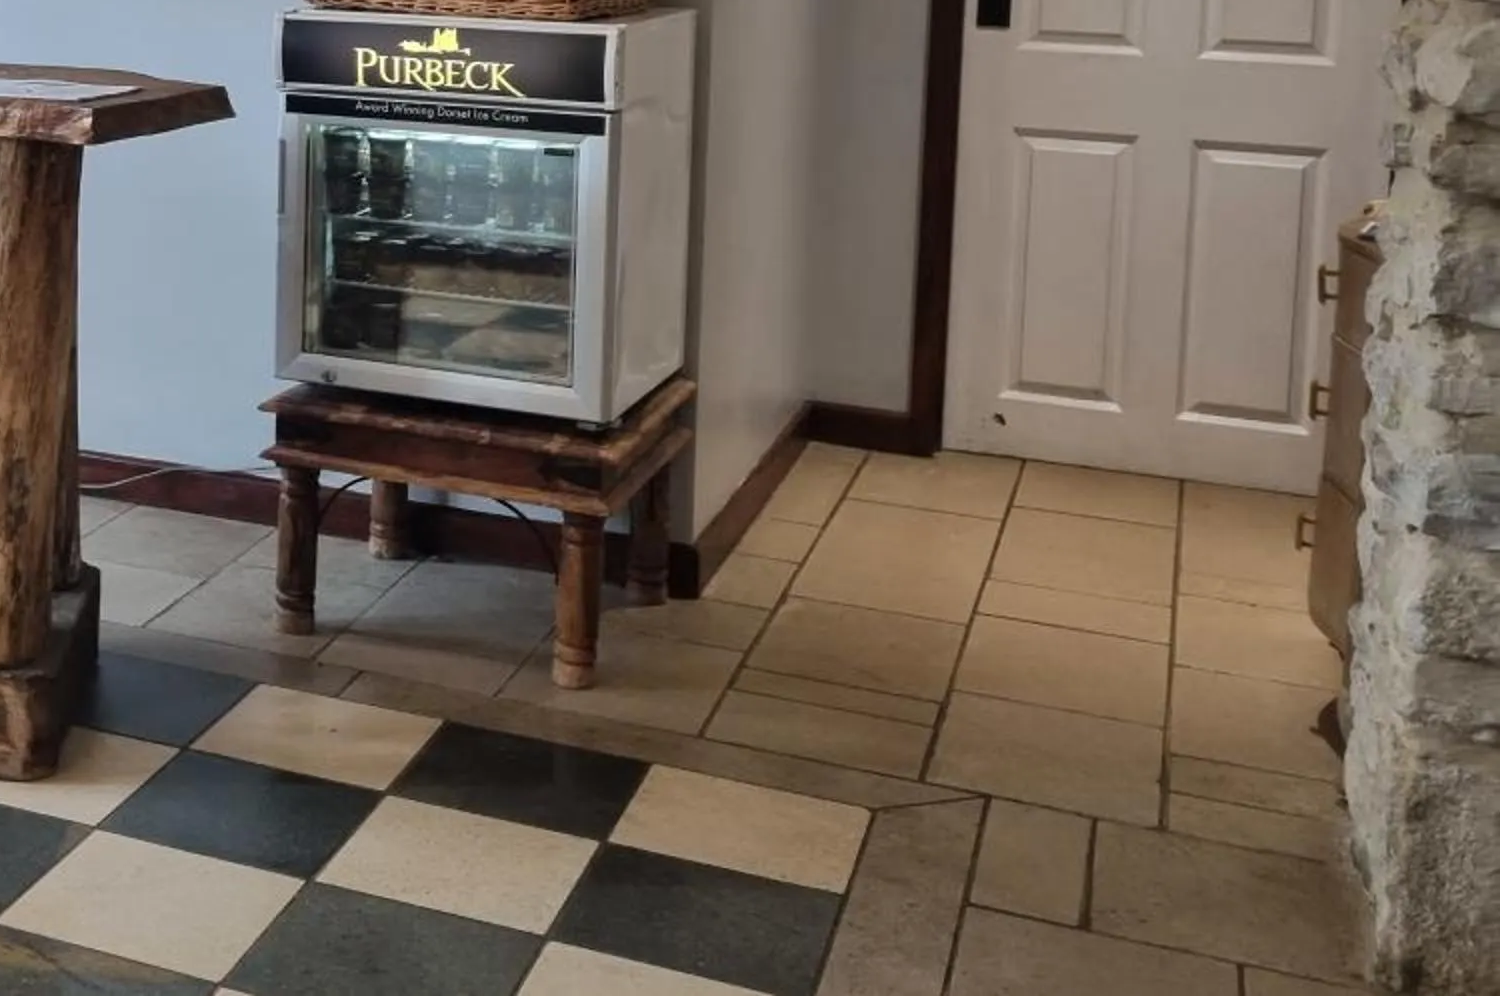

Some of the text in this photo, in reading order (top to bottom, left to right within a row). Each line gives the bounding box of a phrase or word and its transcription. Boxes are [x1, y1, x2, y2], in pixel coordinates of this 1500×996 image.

[353, 47, 527, 98] PURBECK
[355, 100, 529, 123] Award Winning Dorset Ice Cream
